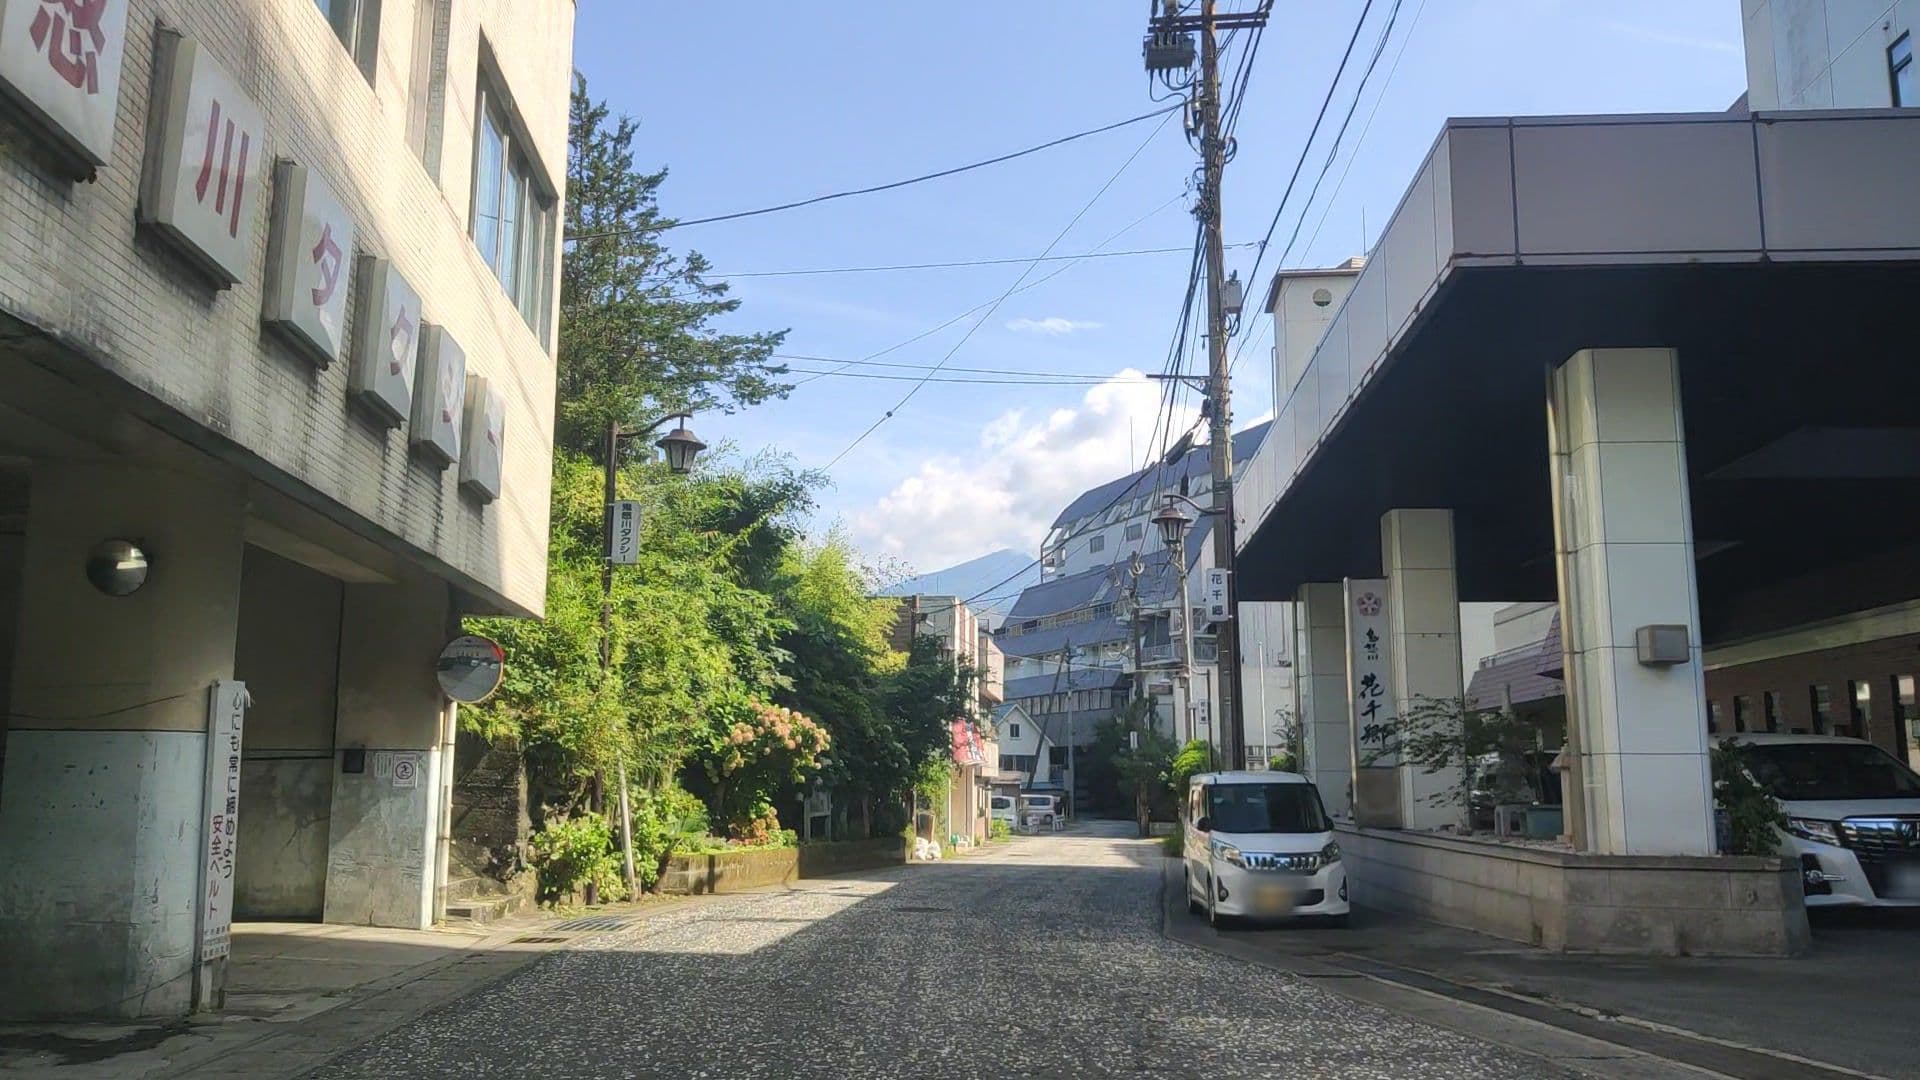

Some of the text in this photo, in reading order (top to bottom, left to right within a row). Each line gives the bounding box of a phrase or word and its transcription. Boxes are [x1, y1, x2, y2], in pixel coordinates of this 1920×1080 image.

[208, 815, 224, 921] 安全ベルト
